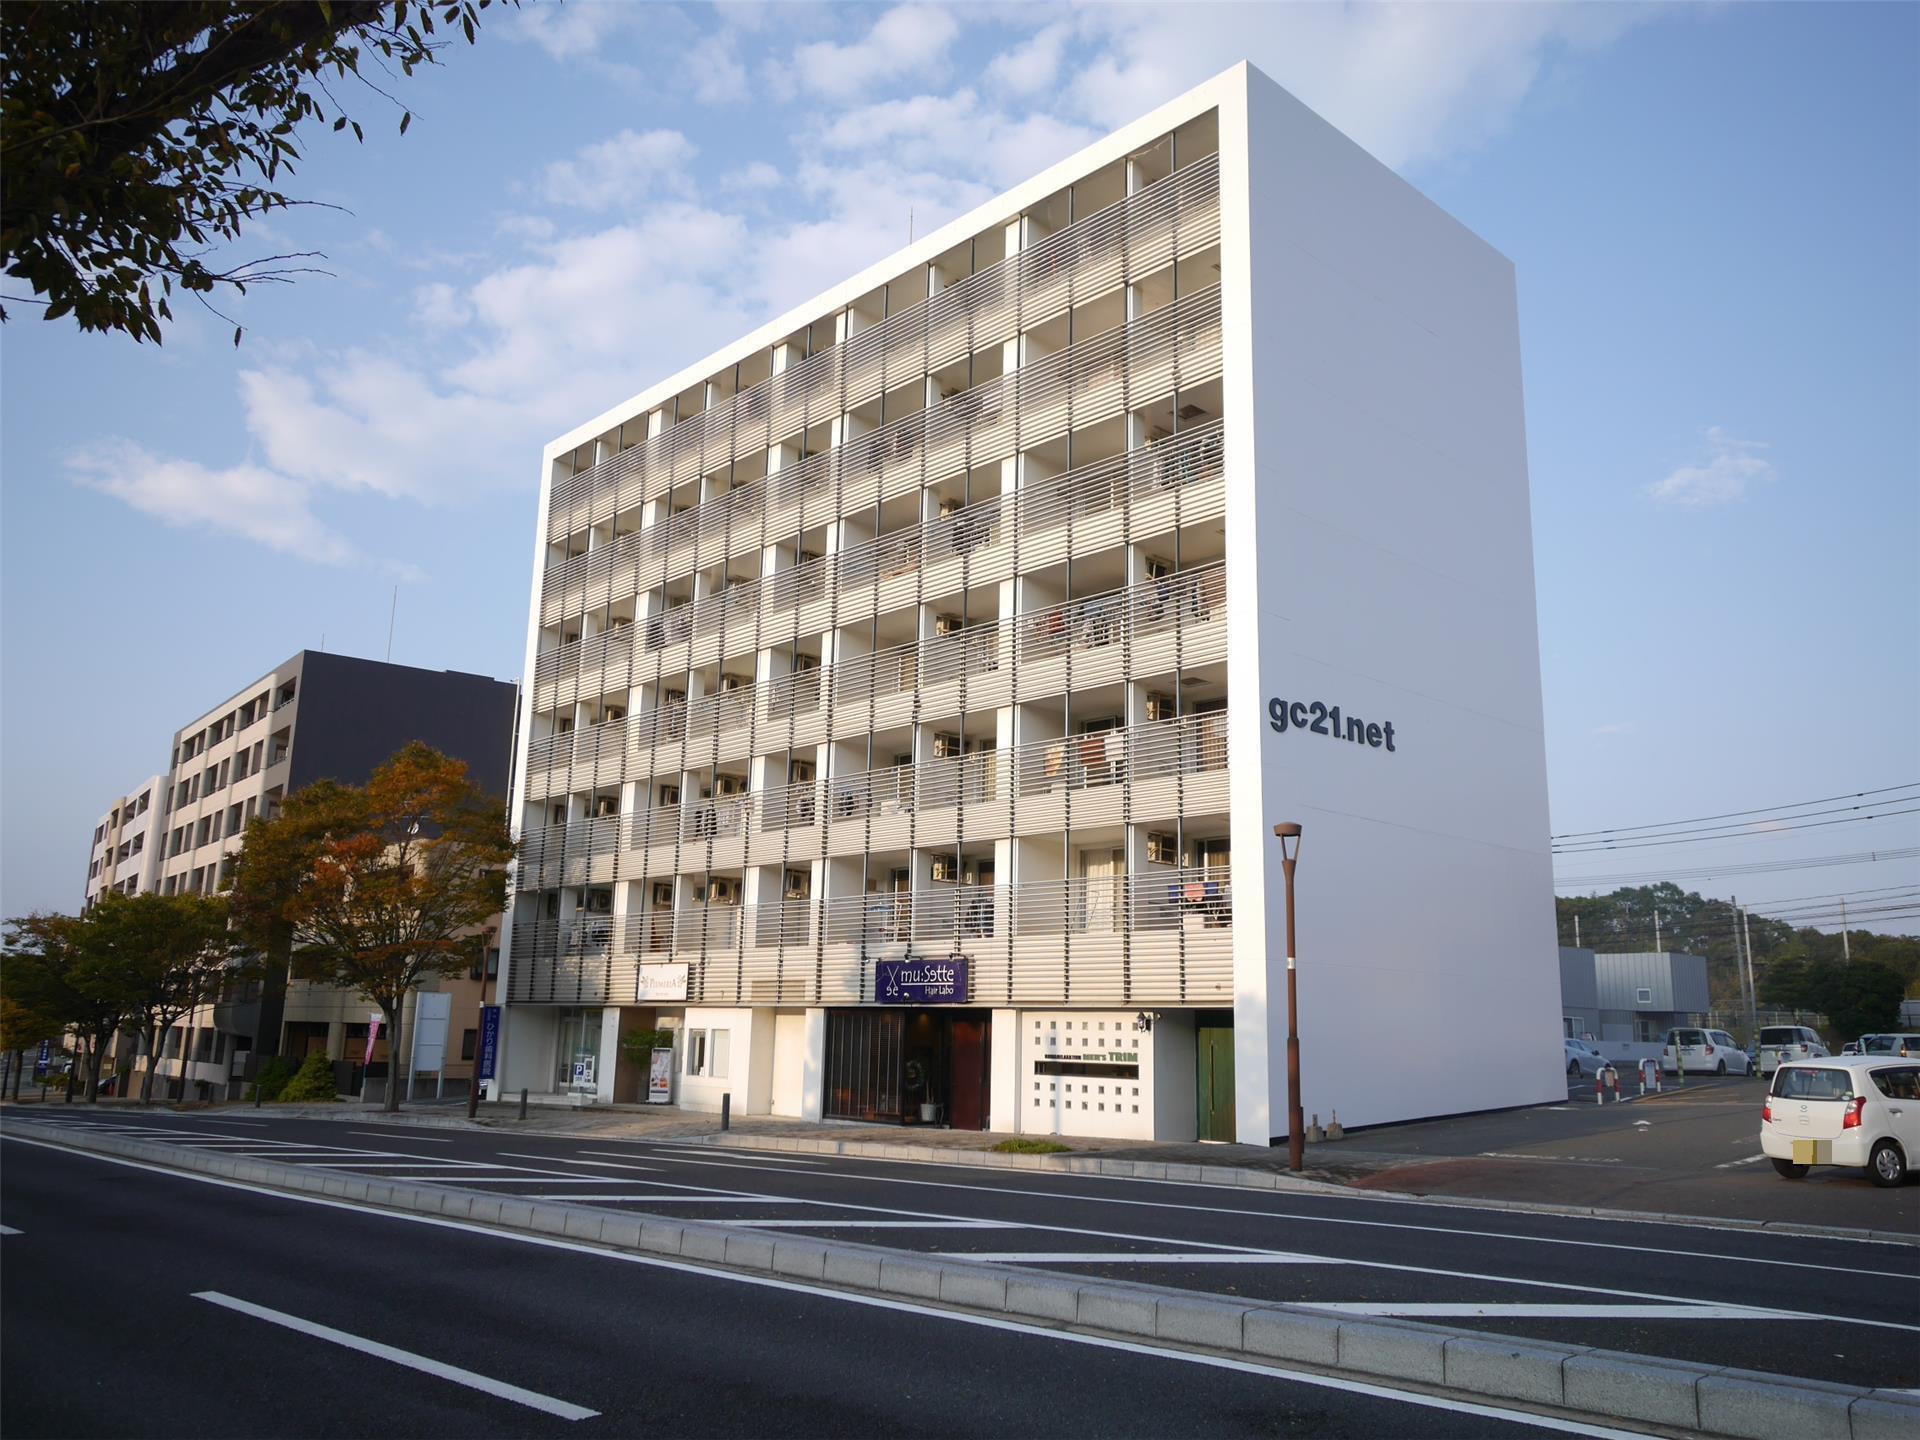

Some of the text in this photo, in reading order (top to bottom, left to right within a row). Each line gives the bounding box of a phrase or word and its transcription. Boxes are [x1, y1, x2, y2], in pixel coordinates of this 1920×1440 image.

[1269, 697, 1396, 752] gc21.net
[925, 985, 954, 996] Hair Labo
[1108, 1051, 1138, 1062] TRIM
[576, 1065, 583, 1075] P
